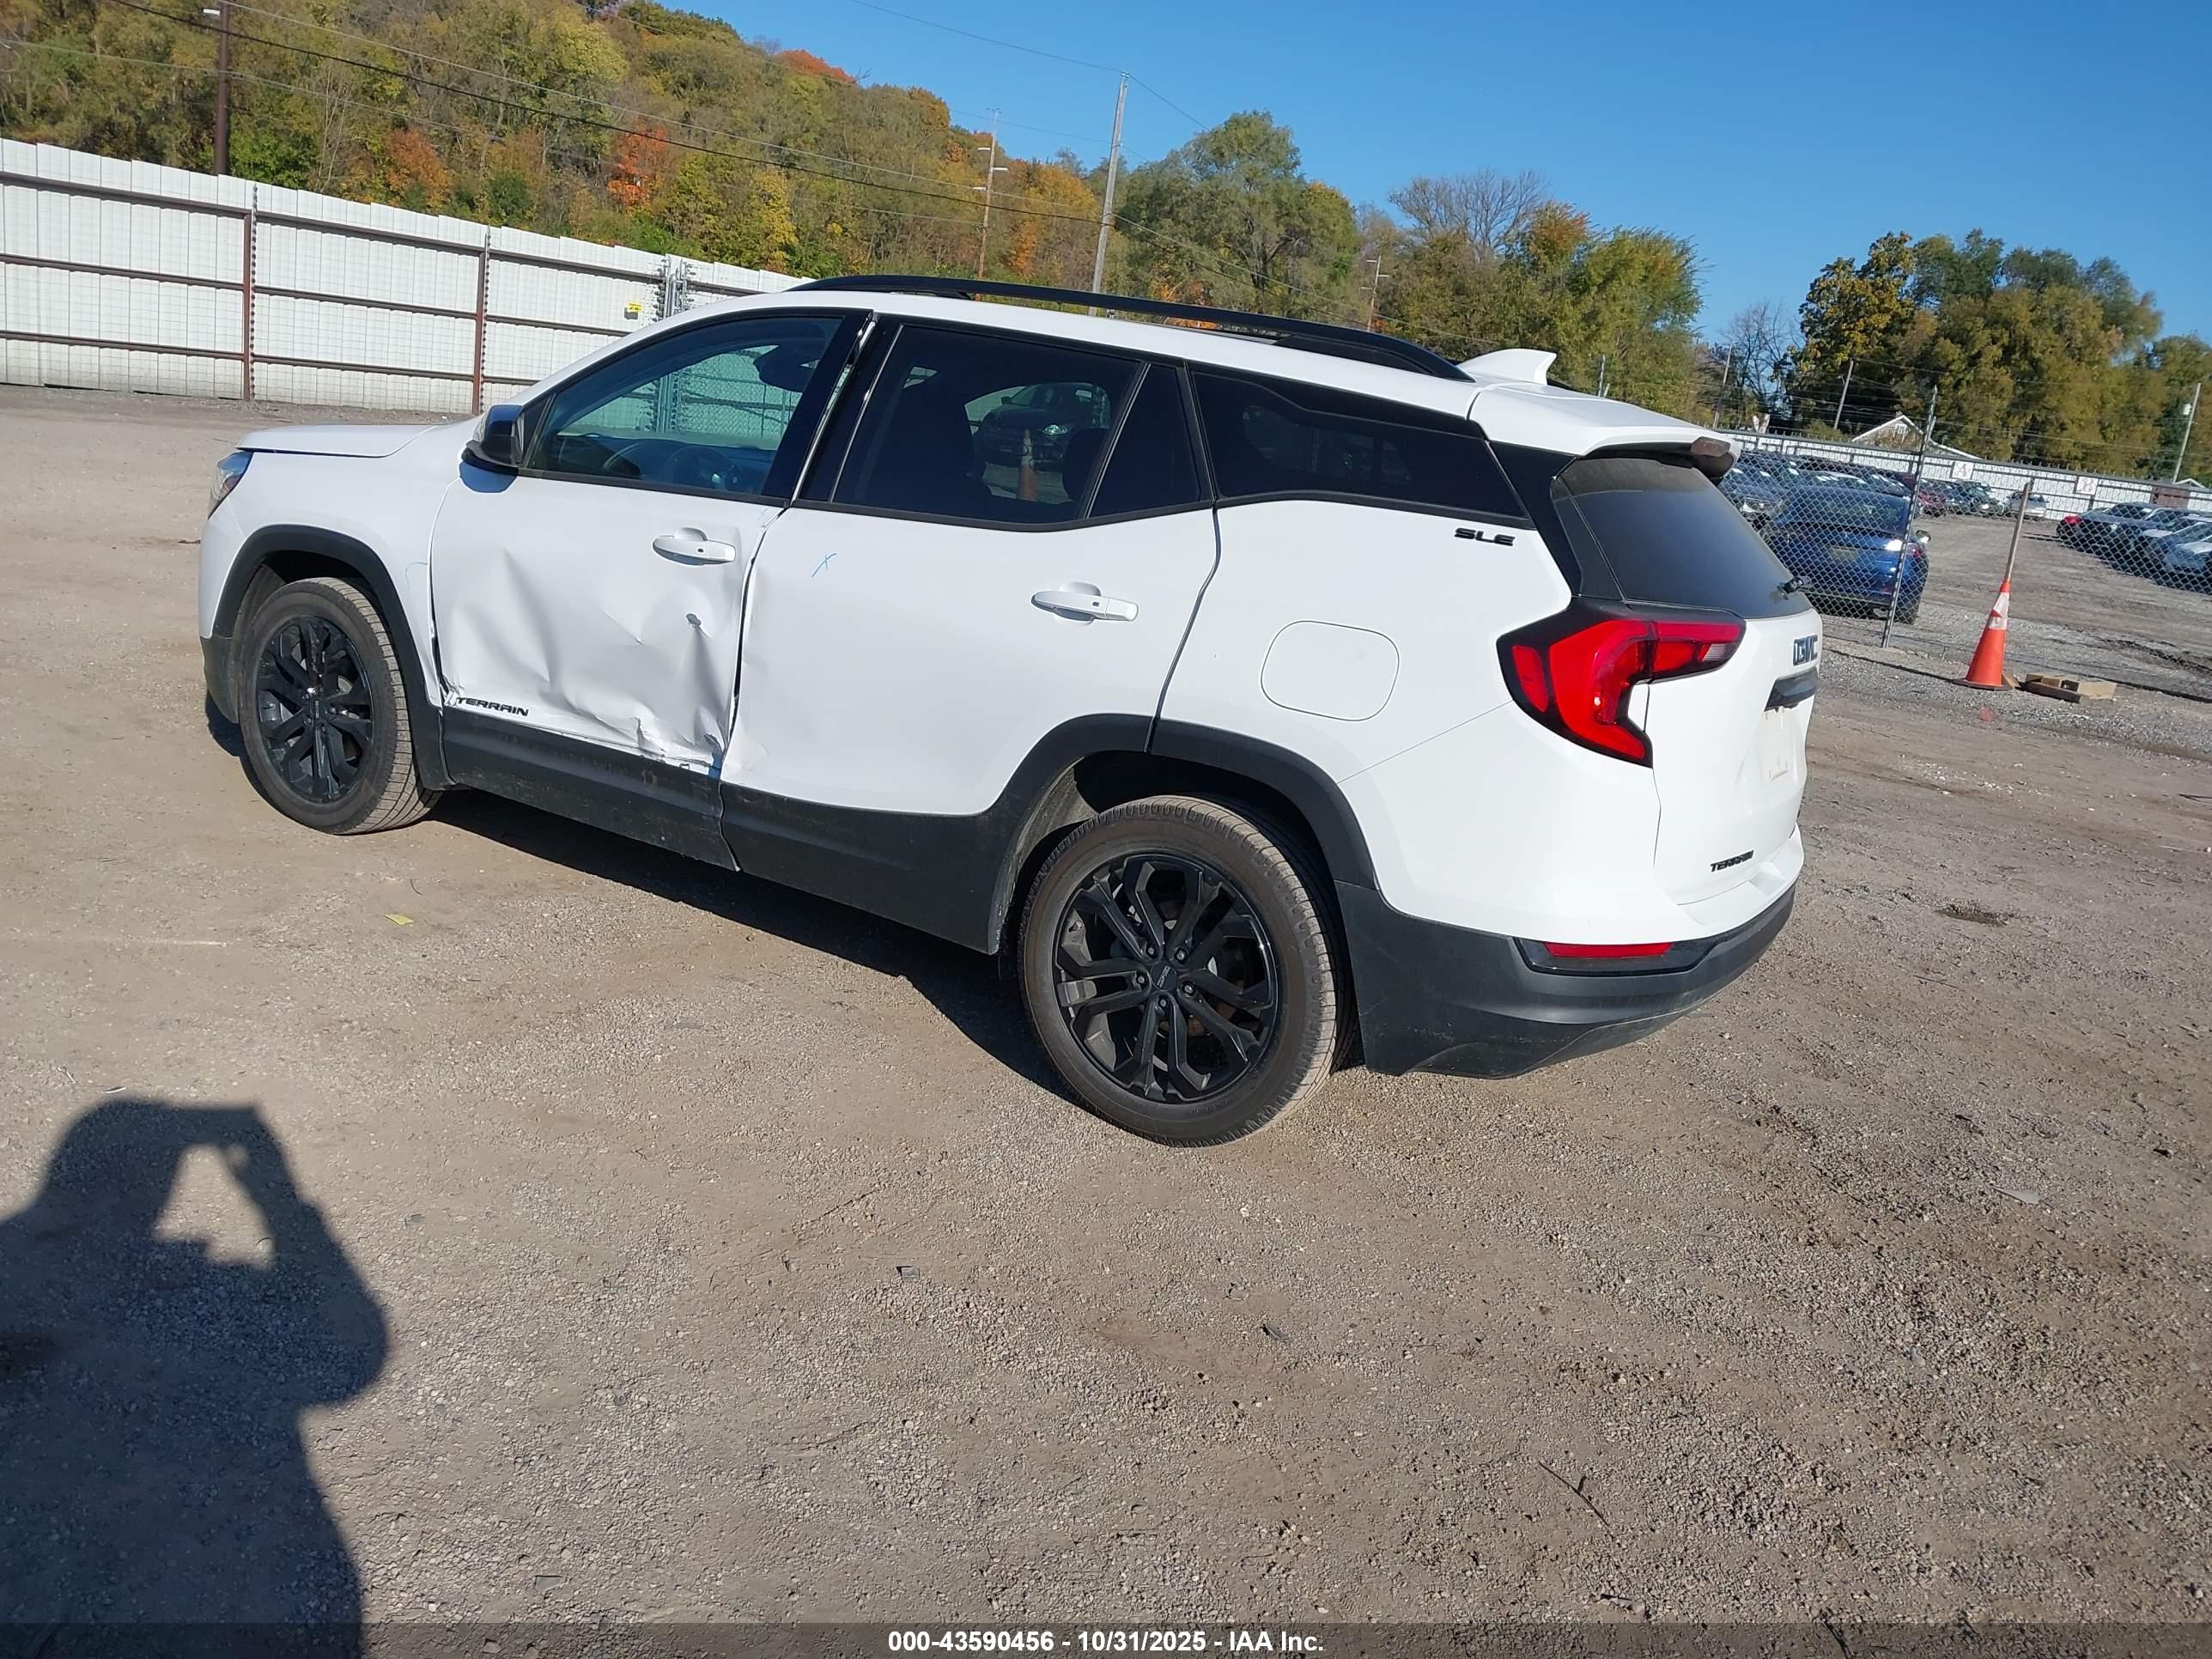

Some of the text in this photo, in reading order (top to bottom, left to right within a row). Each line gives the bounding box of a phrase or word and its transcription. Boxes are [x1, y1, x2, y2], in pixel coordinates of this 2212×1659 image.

[1454, 527, 1516, 547] SLE
[1792, 635, 1819, 666] GMC
[456, 696, 530, 717] TERRAIN
